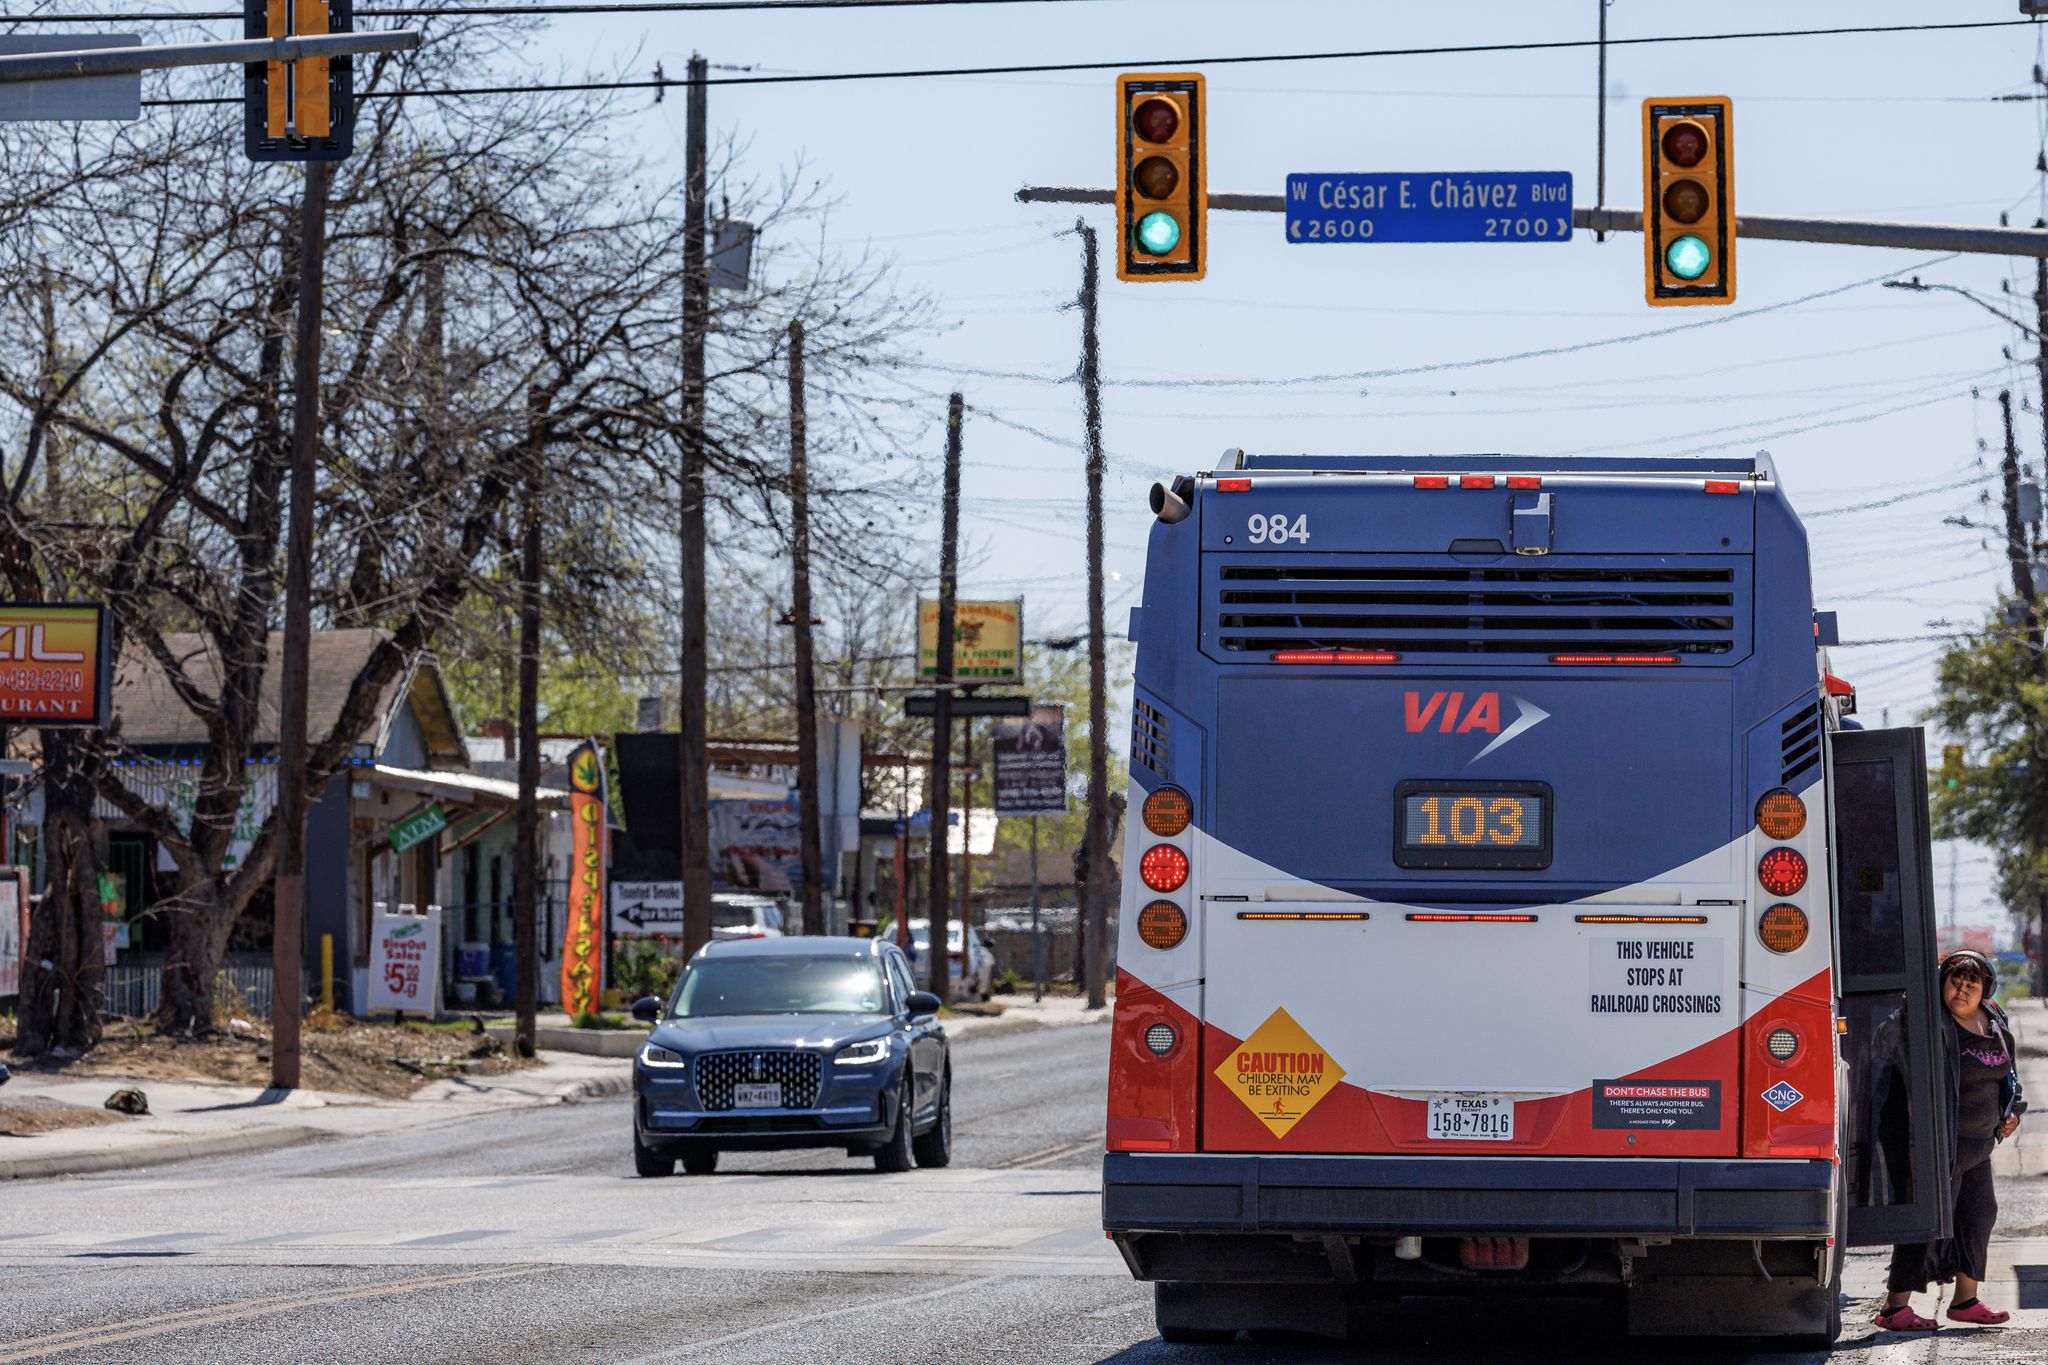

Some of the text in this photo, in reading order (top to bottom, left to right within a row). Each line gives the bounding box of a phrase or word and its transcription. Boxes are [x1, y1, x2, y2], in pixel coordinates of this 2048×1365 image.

[1292, 178, 1567, 209] W César E. Chávez Blvd
[1308, 219, 1374, 238] 2600
[1485, 218, 1548, 237] 2700
[1248, 513, 1310, 544] 984
[1404, 691, 1501, 733] VIA
[398, 811, 442, 846] ATM
[1419, 797, 1523, 844] 103
[629, 907, 684, 921] Parkin
[386, 949, 421, 961] Sales
[1617, 941, 1694, 959] THIS VEHICLE
[1627, 968, 1683, 986] STOPS AT
[1591, 994, 1721, 1013] RAILROAD CROSSINGS
[1237, 1052, 1324, 1073] CAUTION
[1237, 1073, 1322, 1085] CHILDREN MAY
[1249, 1085, 1310, 1096] BE EXITING
[1605, 1088, 1707, 1097] DON'T CHASE THE BUS
[1769, 1090, 1796, 1101] CNG
[1455, 1100, 1488, 1109] TEXAS
